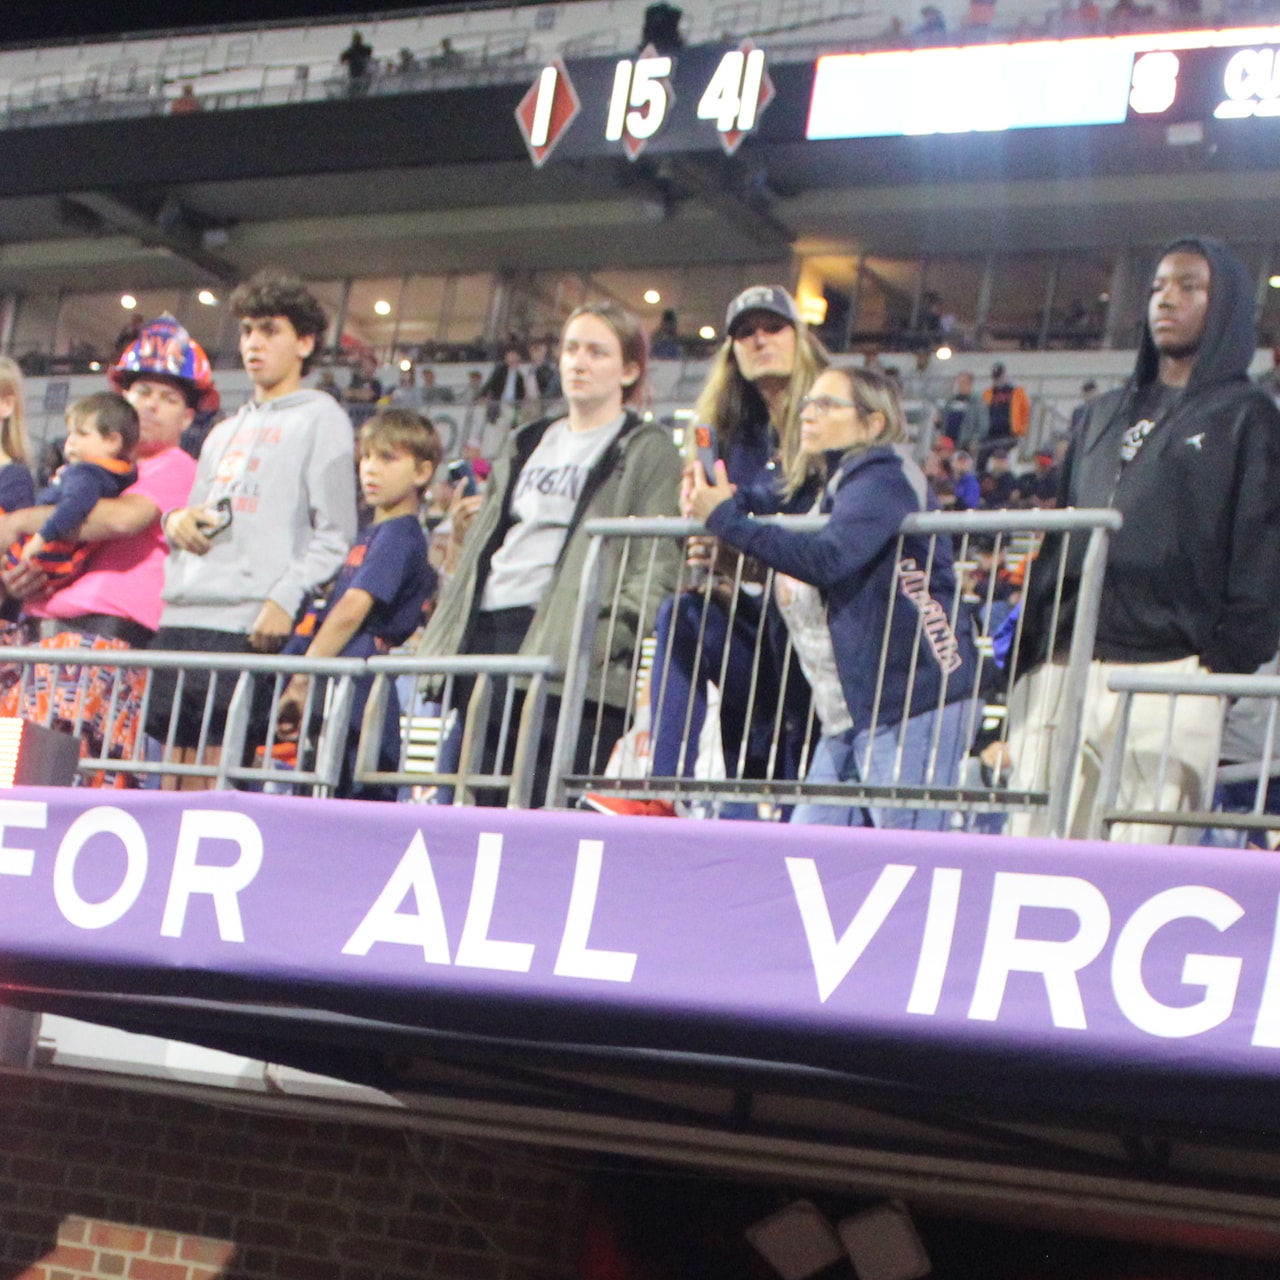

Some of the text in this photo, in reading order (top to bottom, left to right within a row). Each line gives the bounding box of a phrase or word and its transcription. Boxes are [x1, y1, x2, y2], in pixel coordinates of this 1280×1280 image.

[605, 57, 672, 141] 15
[697, 49, 765, 132] 41
[342, 829, 637, 984] ALL
